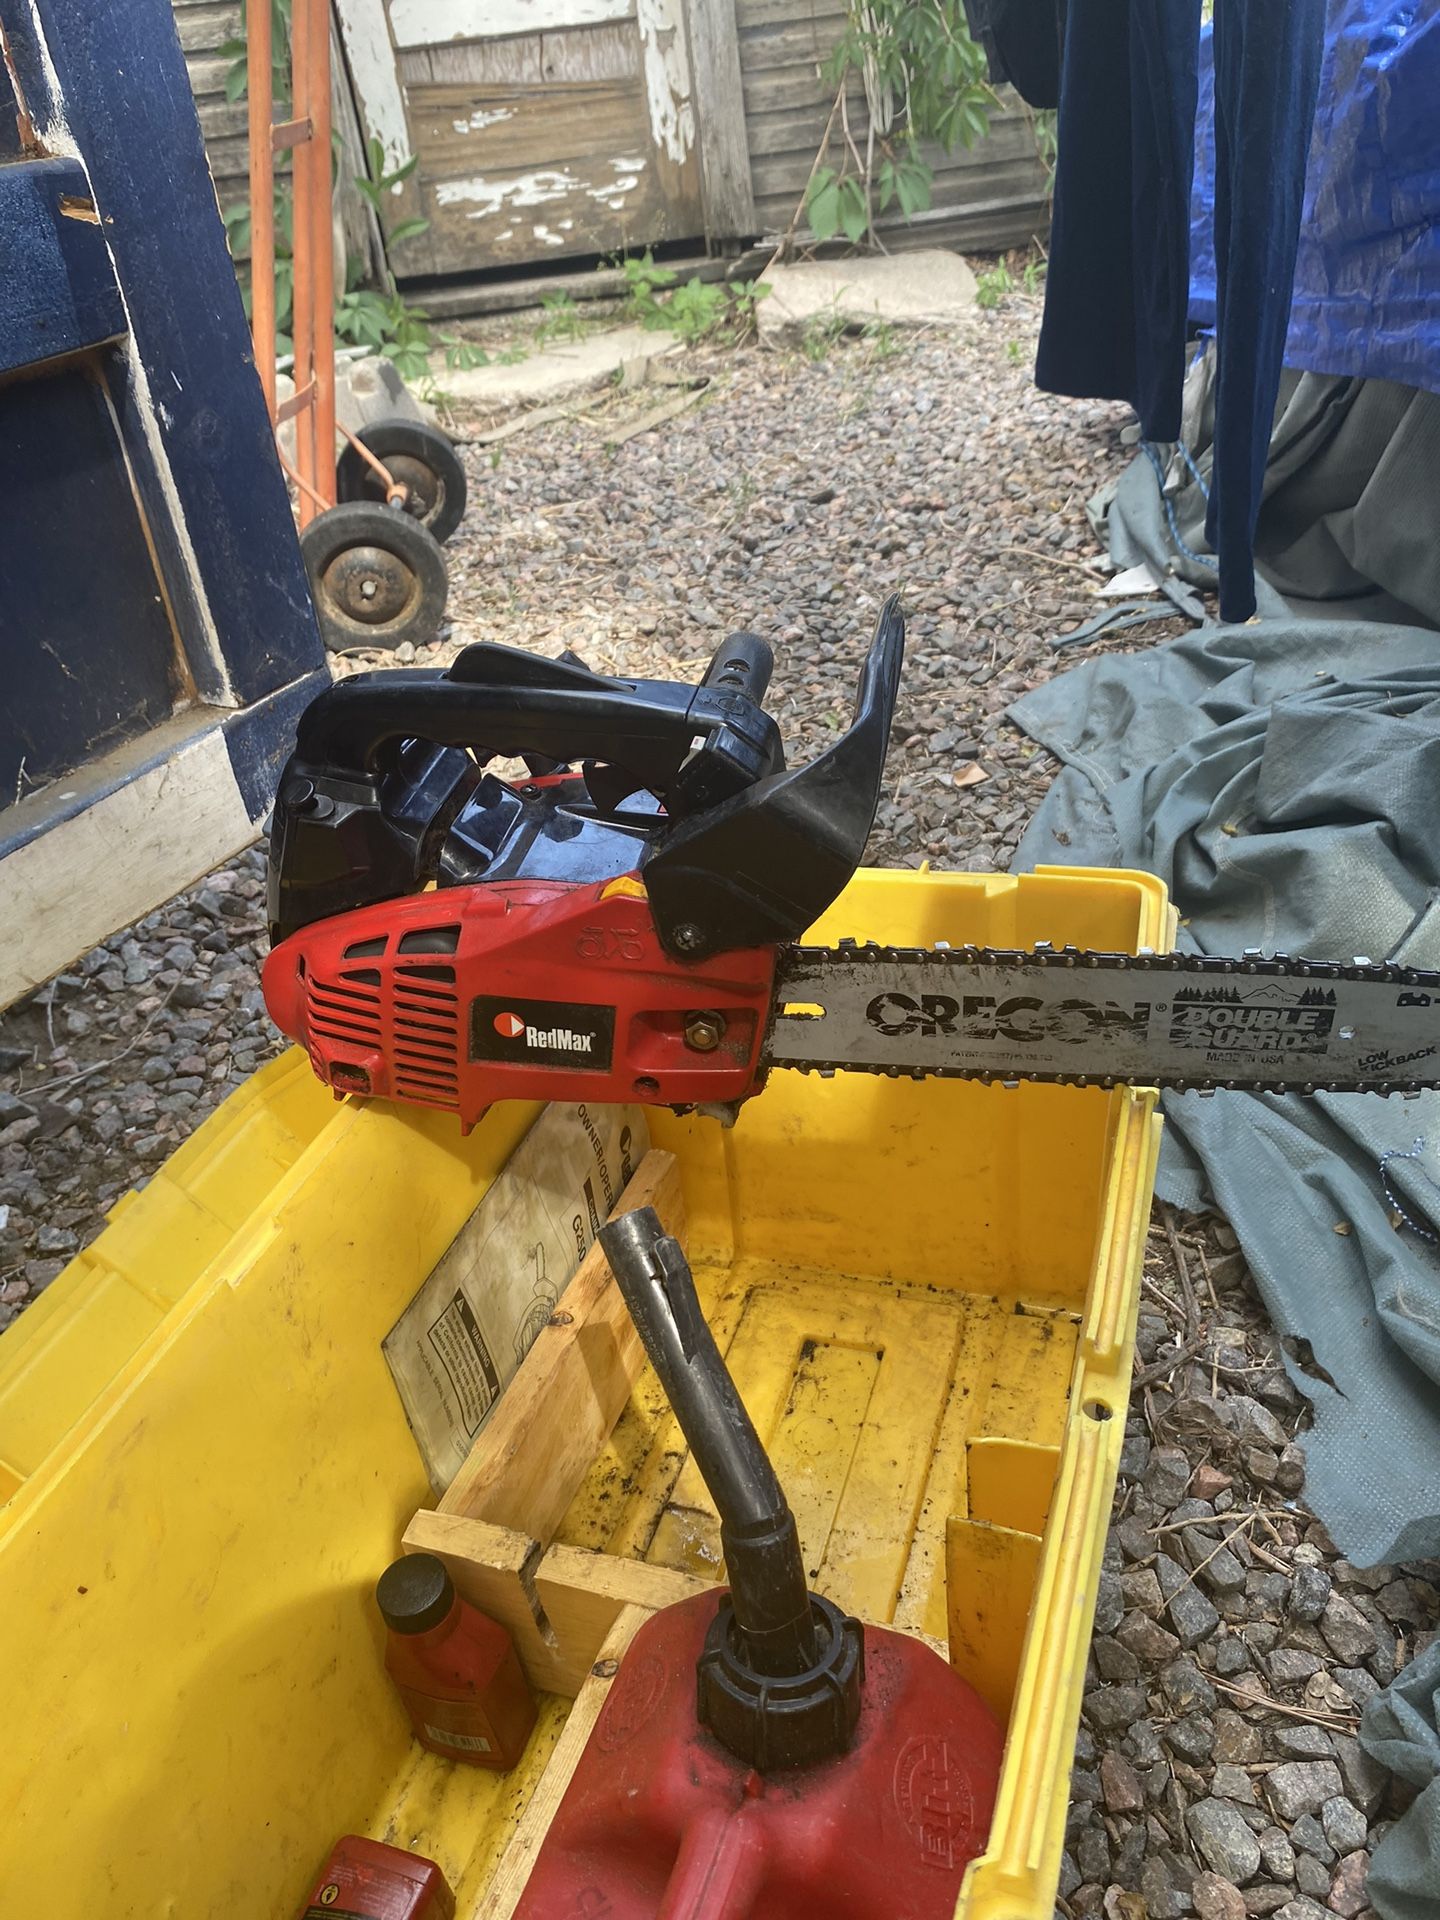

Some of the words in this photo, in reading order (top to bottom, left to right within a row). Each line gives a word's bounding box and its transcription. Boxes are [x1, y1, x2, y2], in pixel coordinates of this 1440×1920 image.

[866, 992, 1151, 1044] OREGON
[1179, 1006, 1319, 1031] DOUBLE
[526, 1026, 592, 1052] RedMax
[1260, 1053, 1285, 1065] USA
[1357, 1050, 1390, 1067] LOW
[471, 1324, 490, 1368] WARNING
